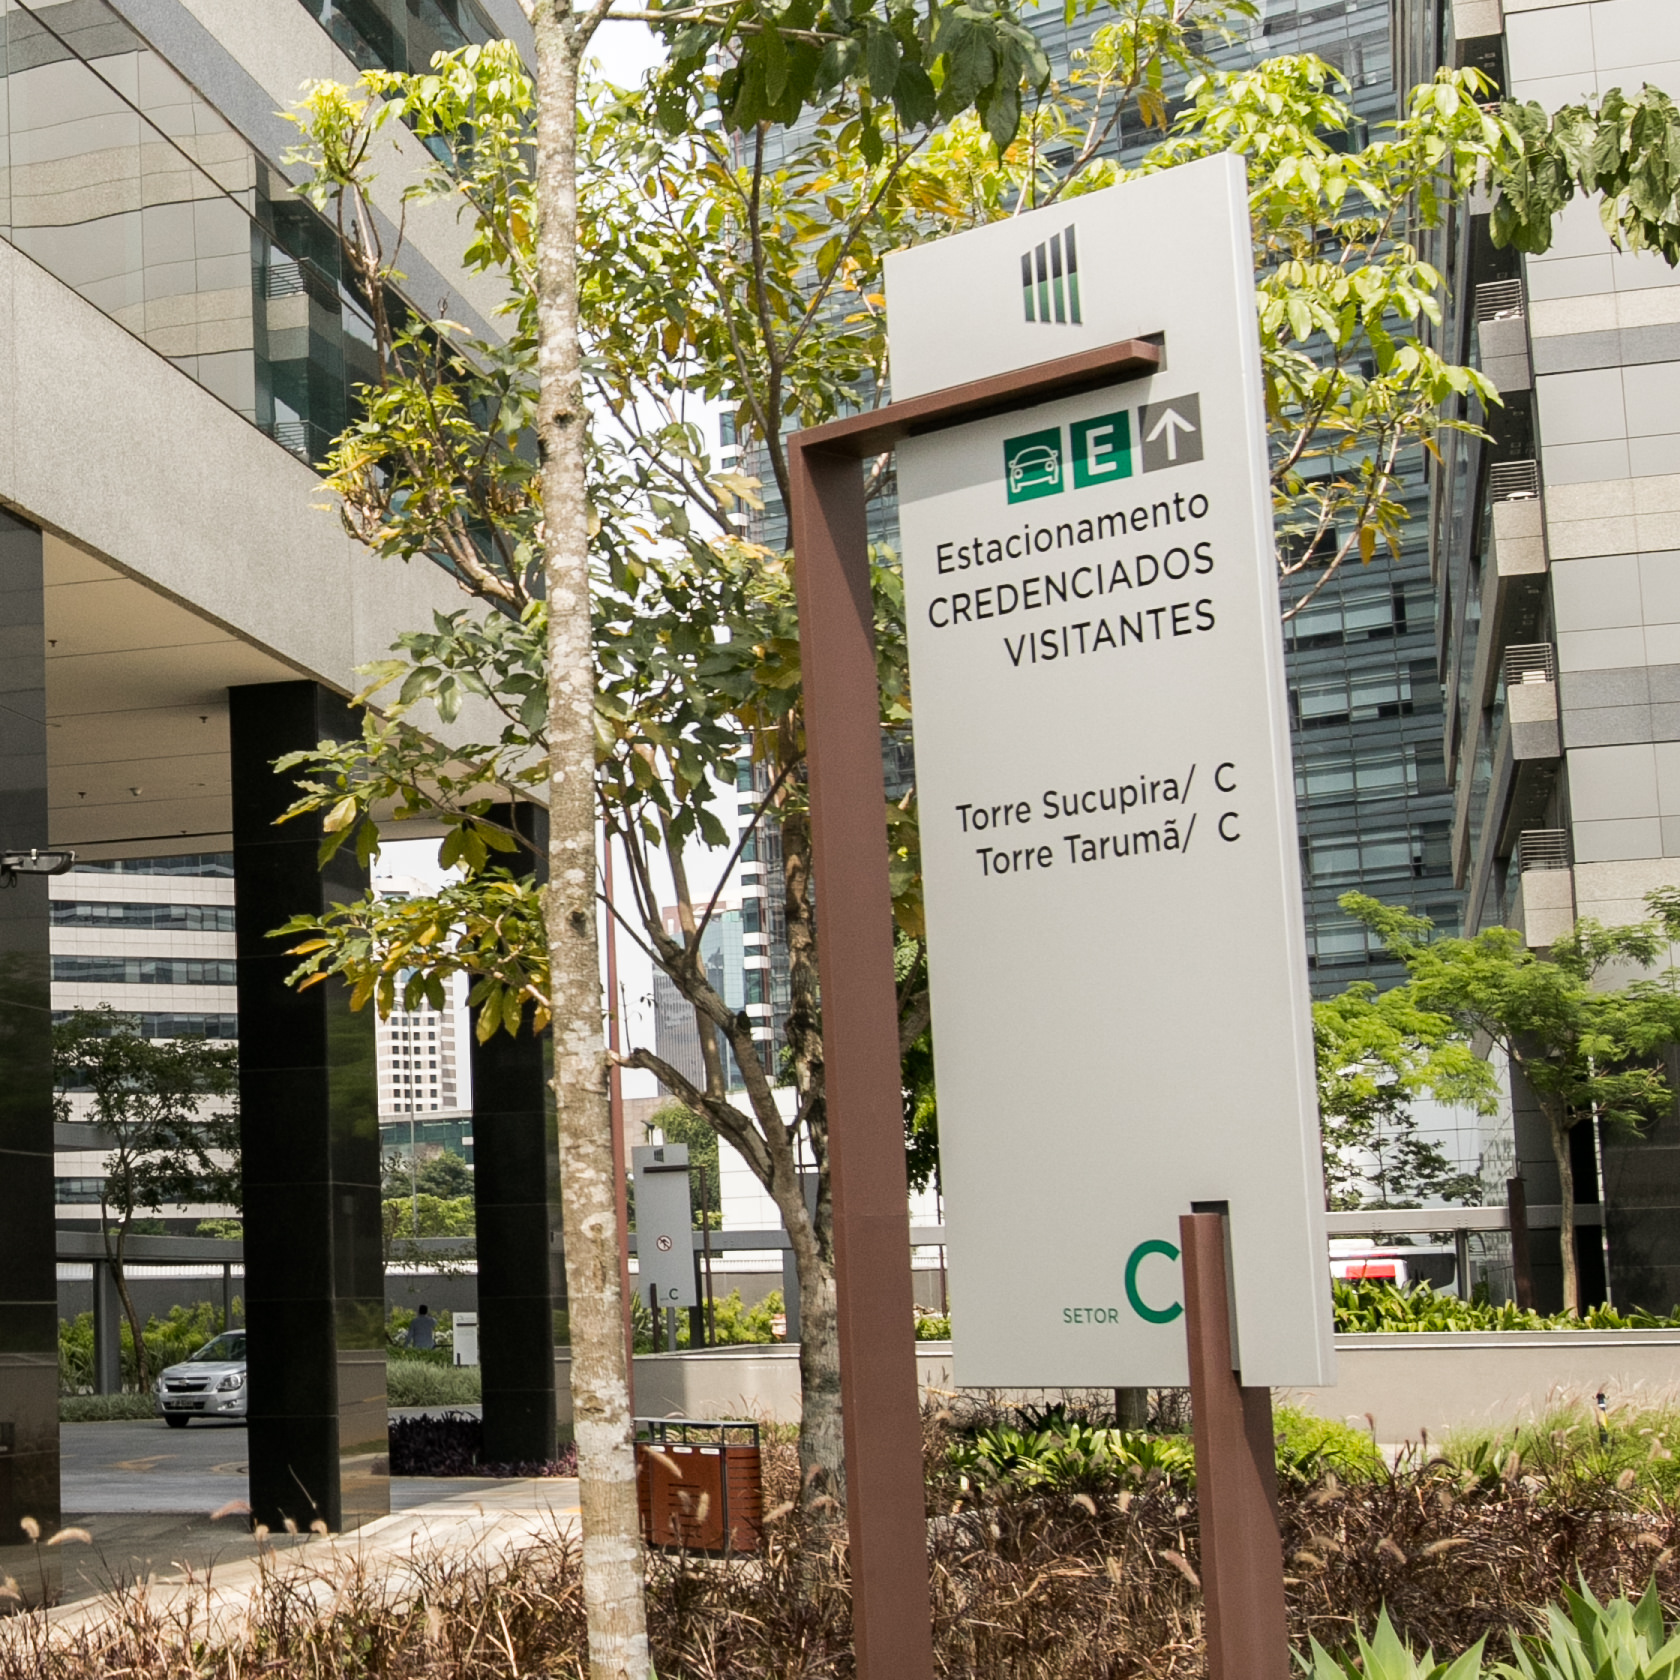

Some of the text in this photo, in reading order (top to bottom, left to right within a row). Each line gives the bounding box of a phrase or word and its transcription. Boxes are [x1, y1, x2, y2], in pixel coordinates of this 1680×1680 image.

[1085, 424, 1118, 475] E
[936, 492, 1209, 575] Estacionamento
[928, 541, 1214, 628] CREDENCIADOS
[1003, 598, 1215, 667] VISITANTES
[955, 762, 1238, 833] Torre Sucupira/ C
[975, 811, 1241, 876] Torre Tarumã/ C
[1063, 1239, 1184, 1324] SETOR C
